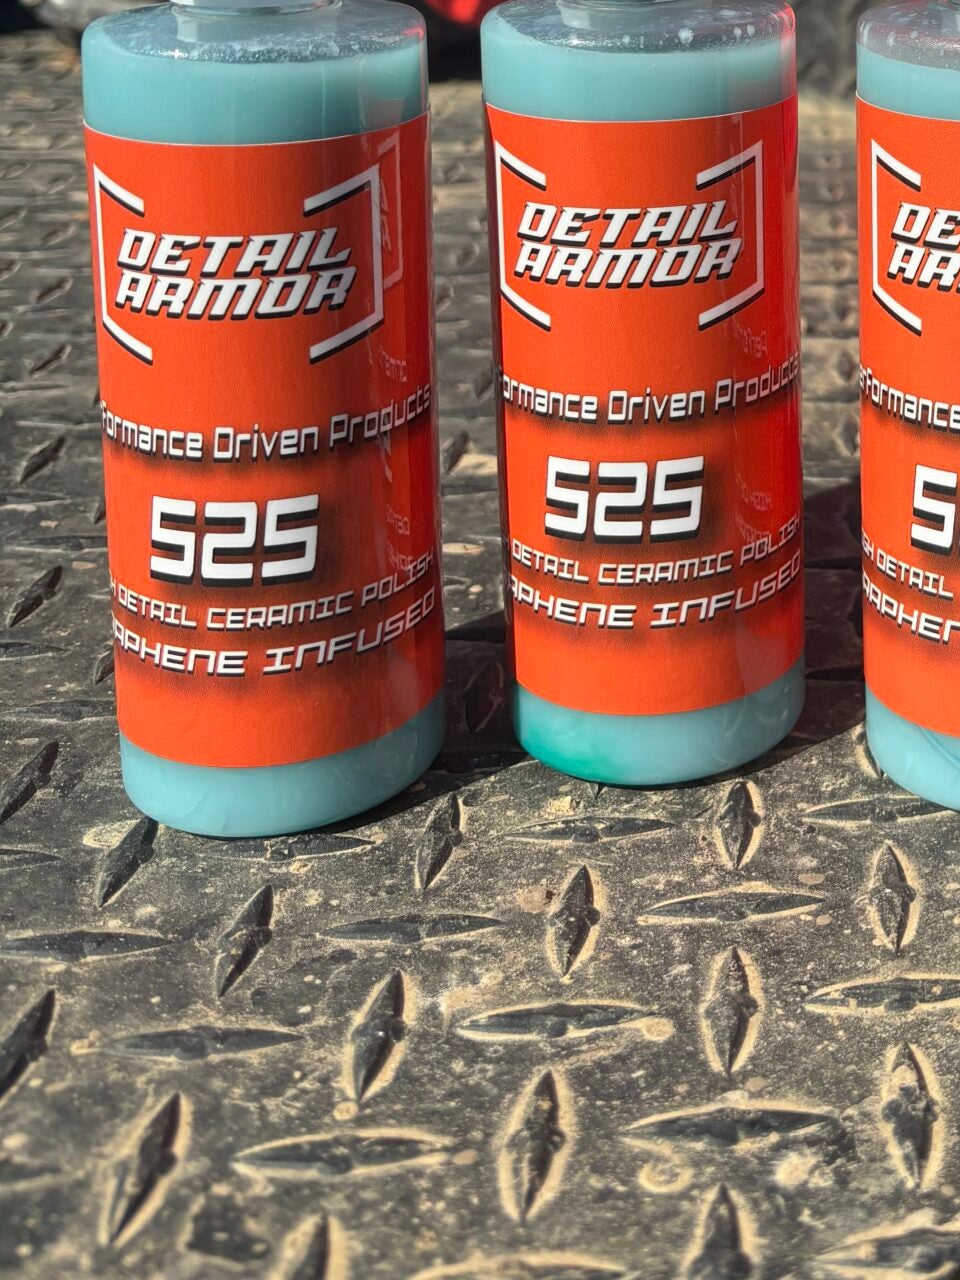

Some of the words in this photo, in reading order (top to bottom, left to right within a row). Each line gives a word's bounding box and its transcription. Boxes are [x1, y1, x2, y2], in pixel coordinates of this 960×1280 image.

[117, 227, 351, 277] DETAIL
[517, 199, 738, 247] DETAIL
[115, 266, 356, 320] ARMOR
[514, 237, 743, 289] ARMOR
[101, 399, 203, 460] formance
[213, 423, 319, 462] Driven
[330, 383, 431, 448] Products
[500, 368, 598, 422] ormance
[608, 387, 705, 424] Driven
[544, 455, 704, 544] 525
[150, 494, 319, 587] 525
[512, 538, 589, 585] DETAIL
[598, 550, 734, 587] CERAMIC
[740, 511, 800, 567] POLISH
[877, 547, 953, 600] DETAIL
[118, 582, 197, 630] DETAIL
[207, 591, 353, 632] CERAMIC
[361, 546, 434, 607] POLISH
[511, 573, 637, 629] APHENE
[651, 547, 801, 629] INFUSED
[112, 610, 248, 677] APHENE
[263, 586, 435, 676] INFUSED
